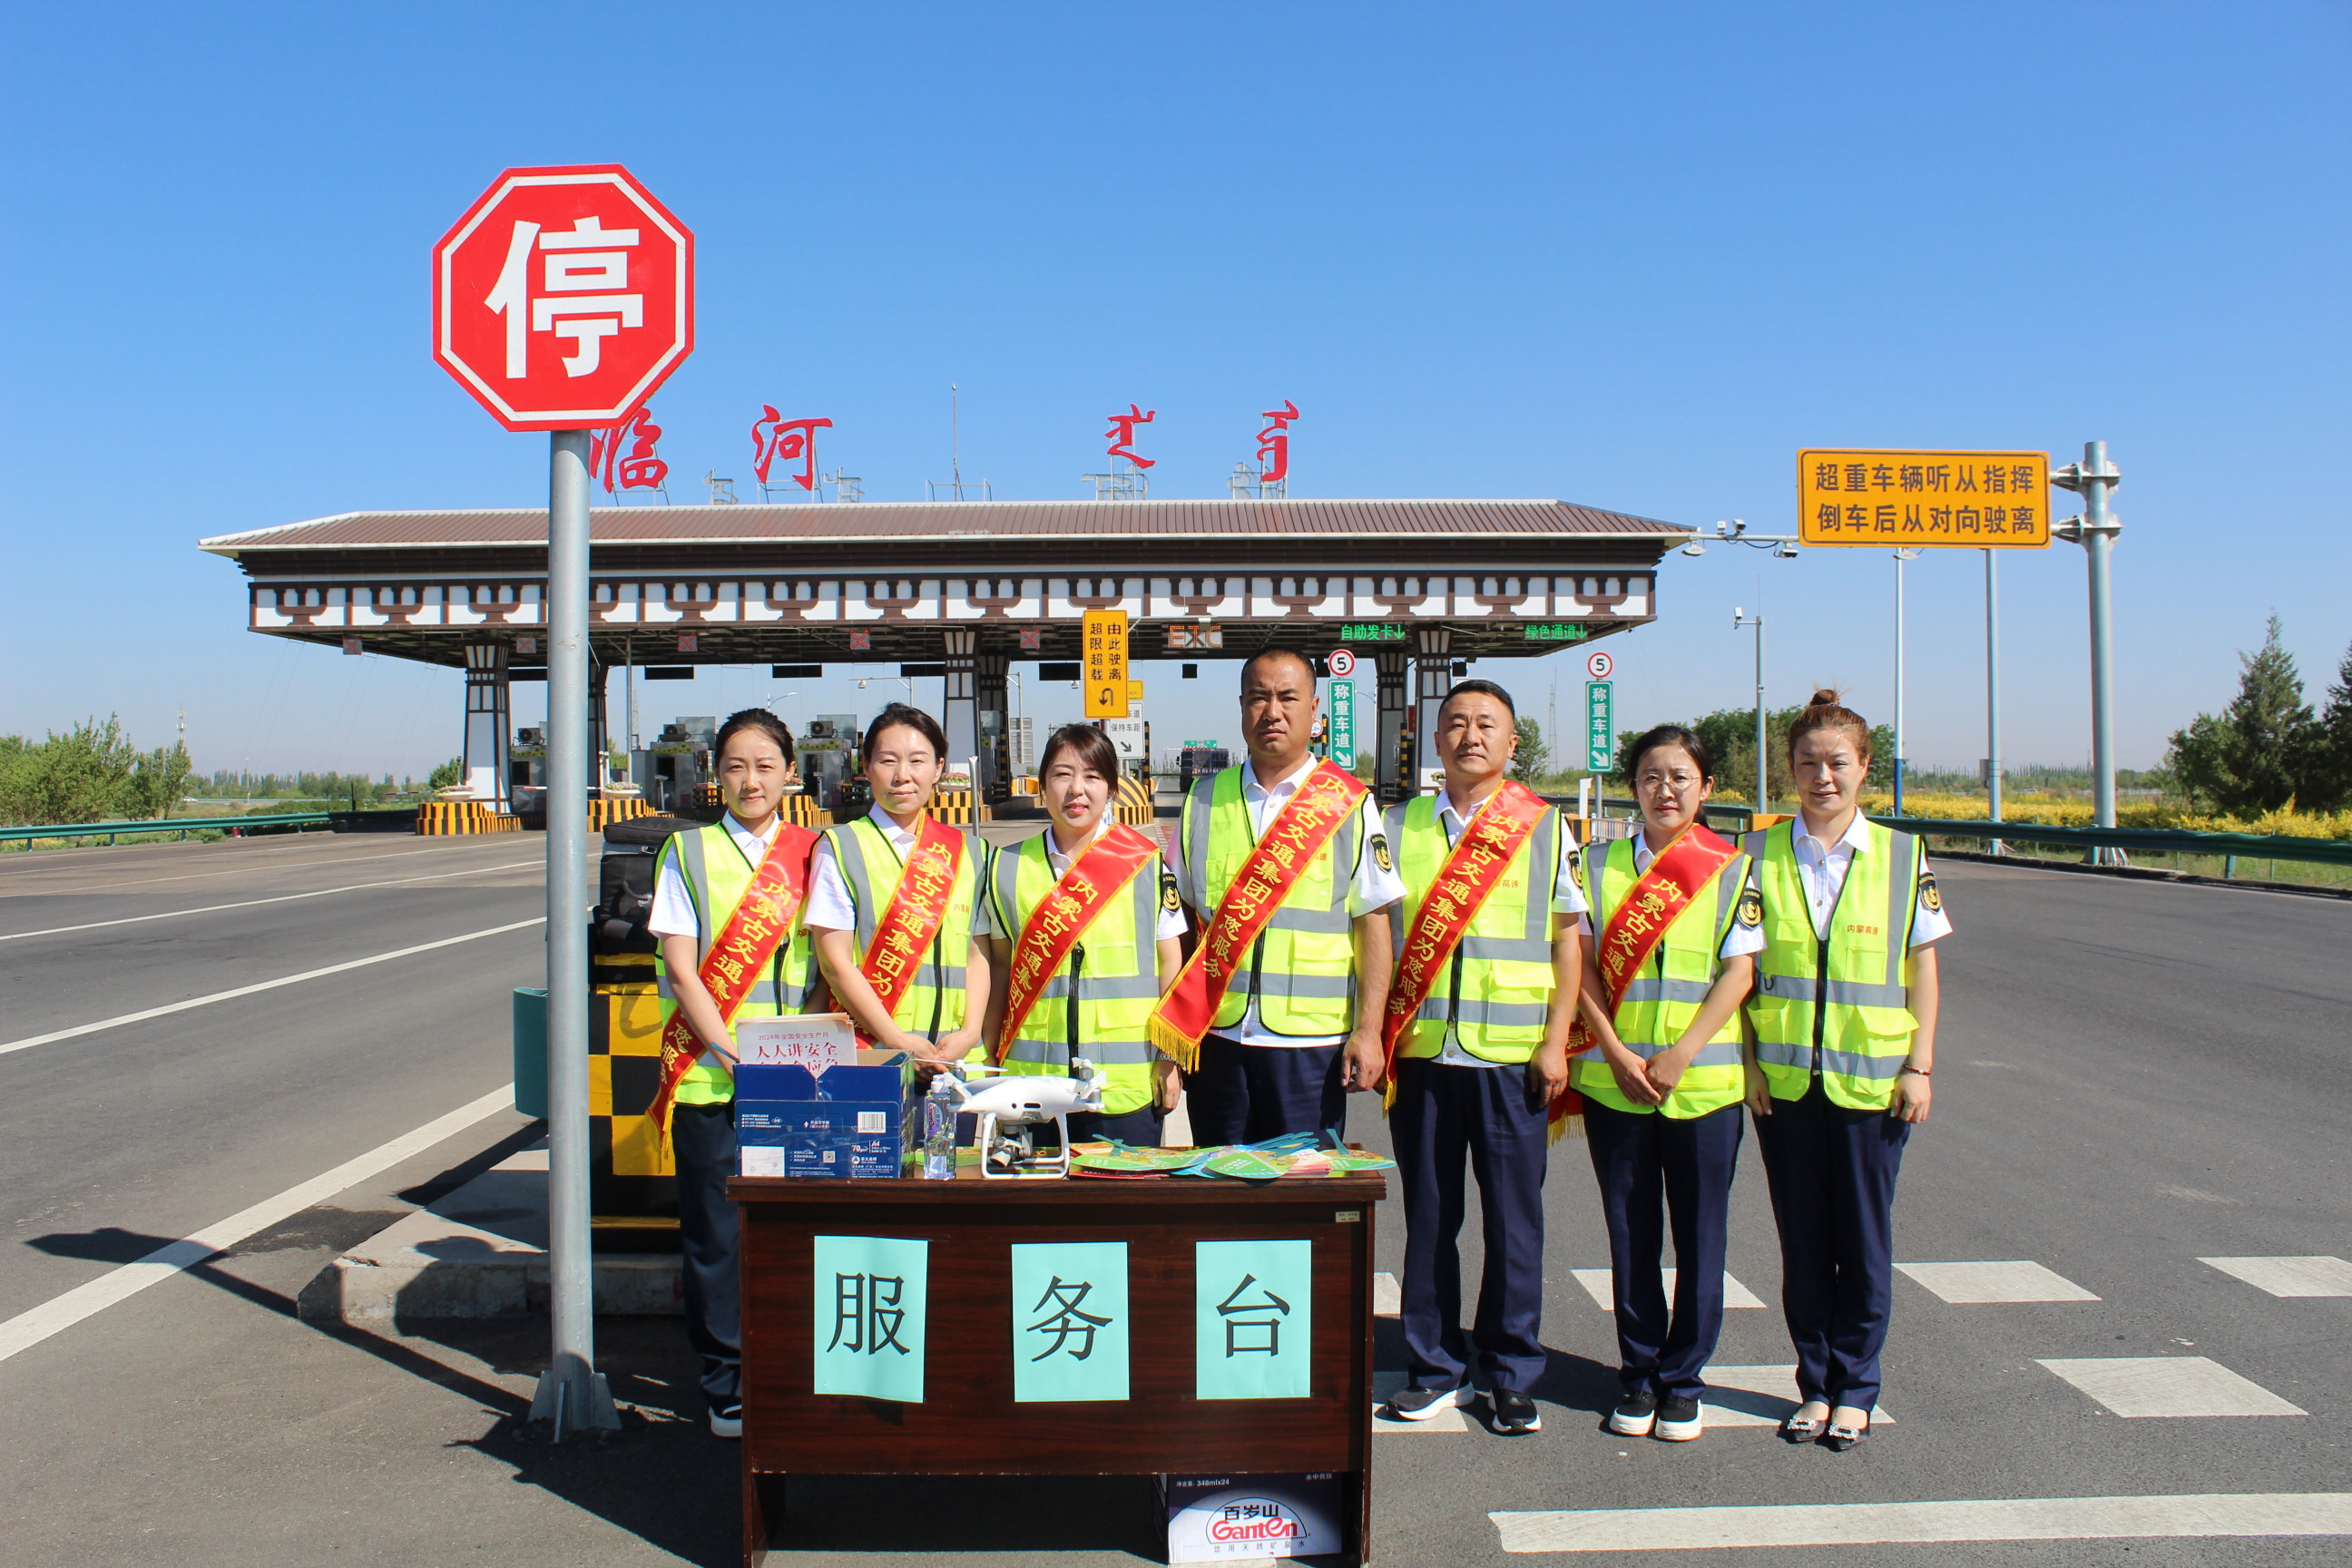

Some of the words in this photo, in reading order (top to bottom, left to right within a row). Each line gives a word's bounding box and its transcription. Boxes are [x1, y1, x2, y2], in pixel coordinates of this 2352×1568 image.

[484, 215, 643, 379] 停
[1816, 462, 2035, 495] 超重车辆听从指挥
[1818, 503, 2035, 535] 倒车后从对向驶离
[1169, 624, 1221, 649] ETC
[1340, 623, 1393, 641] 自助发卡
[1525, 623, 1576, 640] 绿色通道
[1090, 622, 1103, 681] 超限超载
[1107, 622, 1122, 681] 由此驶离
[1337, 657, 1347, 671] 5
[1595, 658, 1605, 671] 5
[1333, 683, 1350, 749] 称重车道
[1592, 686, 1607, 749] 称重车道
[1201, 775, 1349, 978] 内蒙古交通集团为您服务
[1388, 812, 1521, 1016] 内蒙古交通集团为您服务
[853, 840, 953, 1034] 内蒙古交通集团为
[1847, 924, 1879, 936] 内蒙高速
[757, 1042, 838, 1059] 人人讲安全
[758, 1032, 829, 1041] 2024年全国安全生产月
[1223, 1504, 1279, 1522] 百岁山
[1211, 1516, 1298, 1541] Ganten
